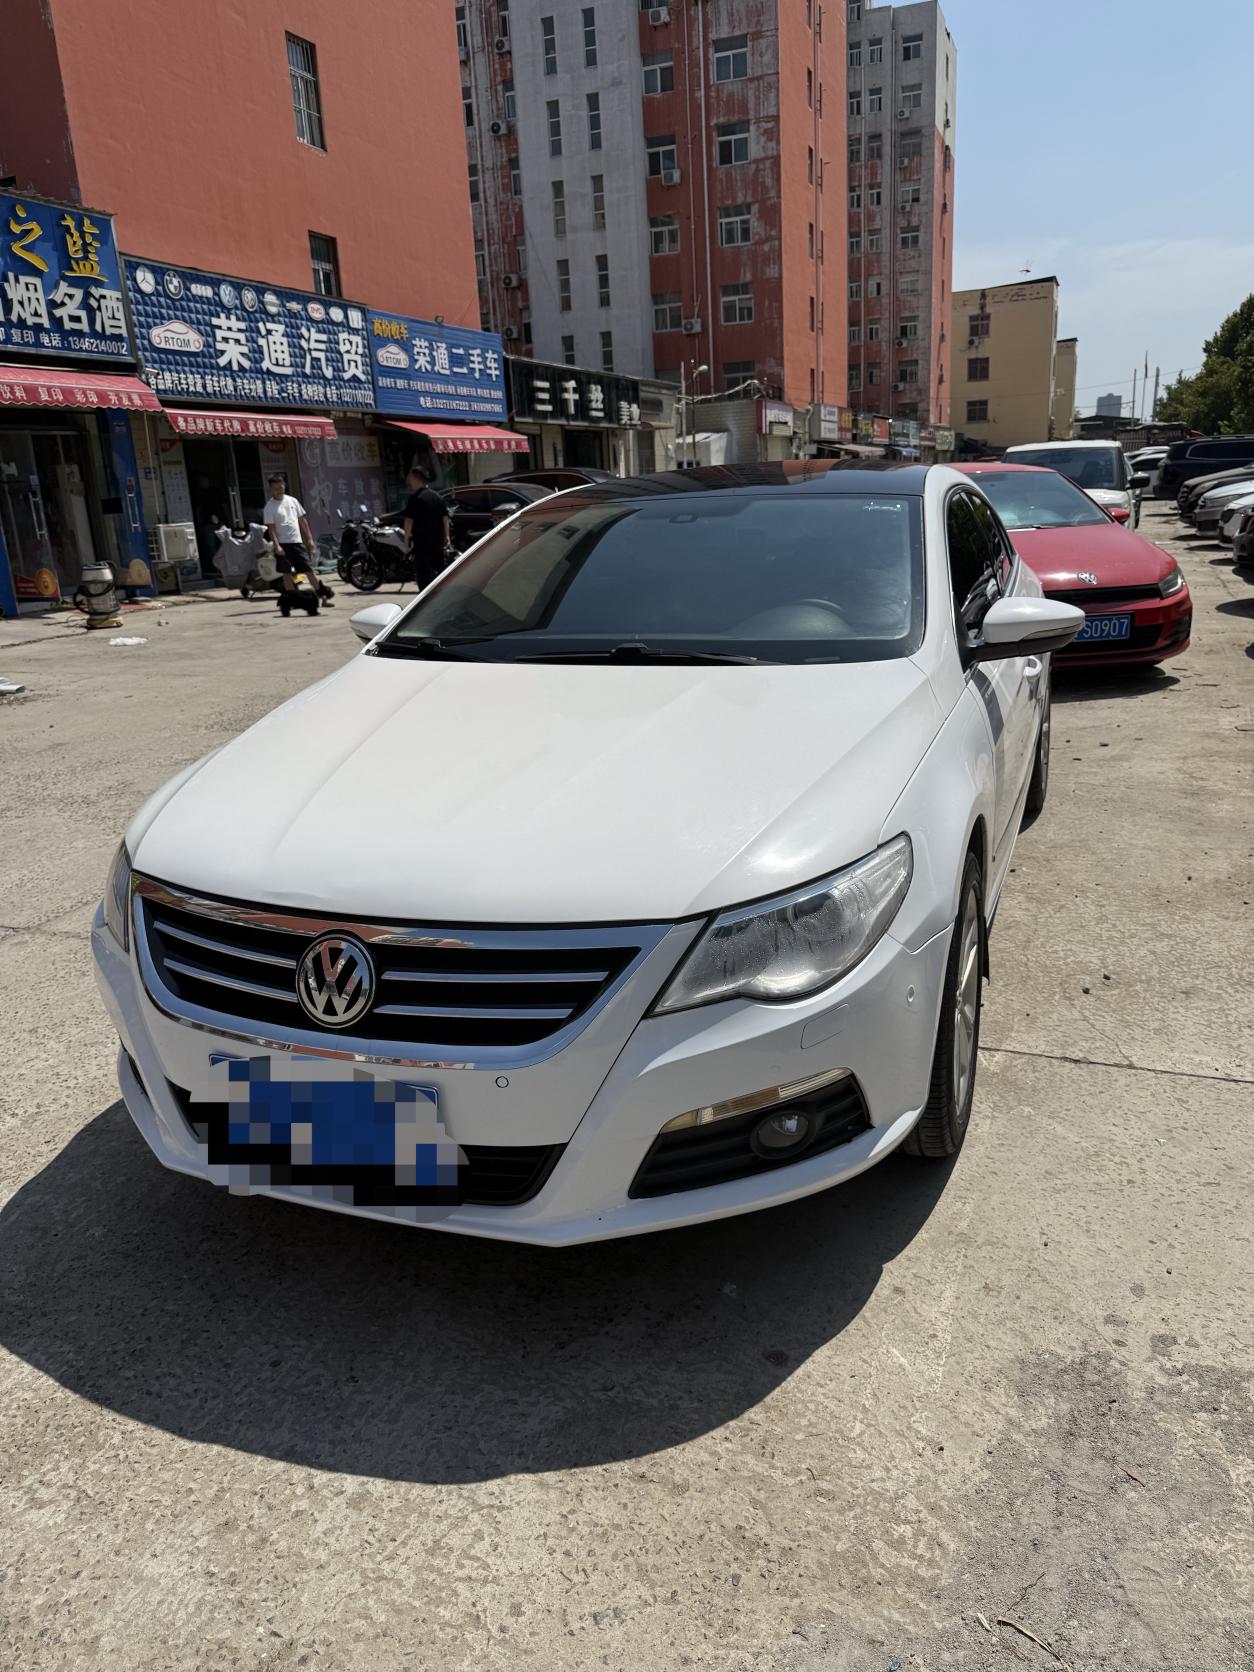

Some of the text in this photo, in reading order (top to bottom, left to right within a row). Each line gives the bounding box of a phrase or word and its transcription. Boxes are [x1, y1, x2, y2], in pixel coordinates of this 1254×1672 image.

[0, 271, 129, 338] 烟名酒
[11, 327, 35, 344] 复印
[211, 313, 366, 381] 荣通汽贸
[412, 338, 500, 381] 荣通二手车
[38, 385, 64, 402] 复印
[533, 380, 605, 418] 三千丝
[1082, 619, 1129, 638] S0907
